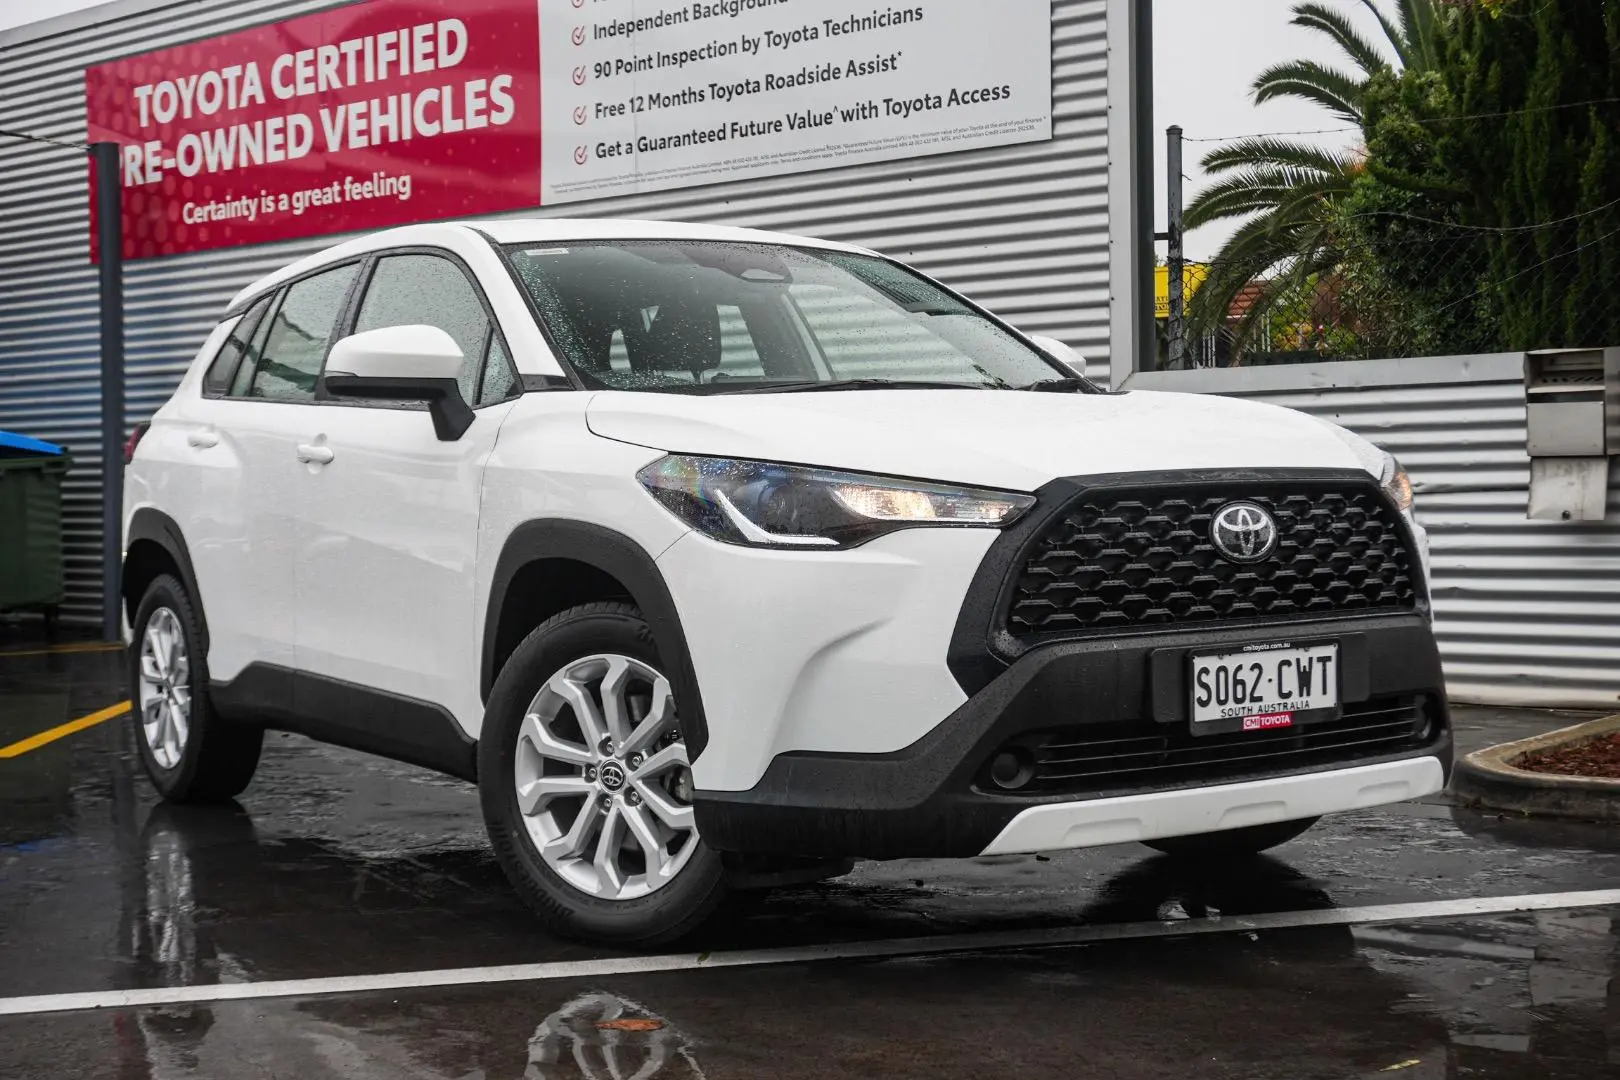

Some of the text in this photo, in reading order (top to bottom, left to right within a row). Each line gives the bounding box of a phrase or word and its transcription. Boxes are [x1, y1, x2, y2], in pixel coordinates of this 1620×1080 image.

[594, 8, 689, 39] Independent
[594, 6, 923, 79] 90 Point Inspection by Toyota Technicians
[134, 18, 468, 128] TOYOTA CERTIFIED
[595, 102, 625, 118] Free
[629, 95, 645, 113] 12
[649, 87, 706, 110] Months
[709, 79, 761, 102] Toyota
[766, 63, 842, 91] Roadside
[120, 74, 515, 187] RE-OWNED VEHICLES
[596, 141, 623, 158] Get
[626, 142, 633, 155] a
[637, 122, 727, 153] Guaranteed
[731, 119, 783, 140] Future
[841, 100, 879, 122] with
[883, 93, 943, 118] Toyota
[947, 85, 1011, 107] Access
[183, 172, 411, 225] Certainty is a great feeling
[1220, 700, 1311, 718] SOUTH AUSTRALIA
[1260, 714, 1291, 726] TOYOTA
